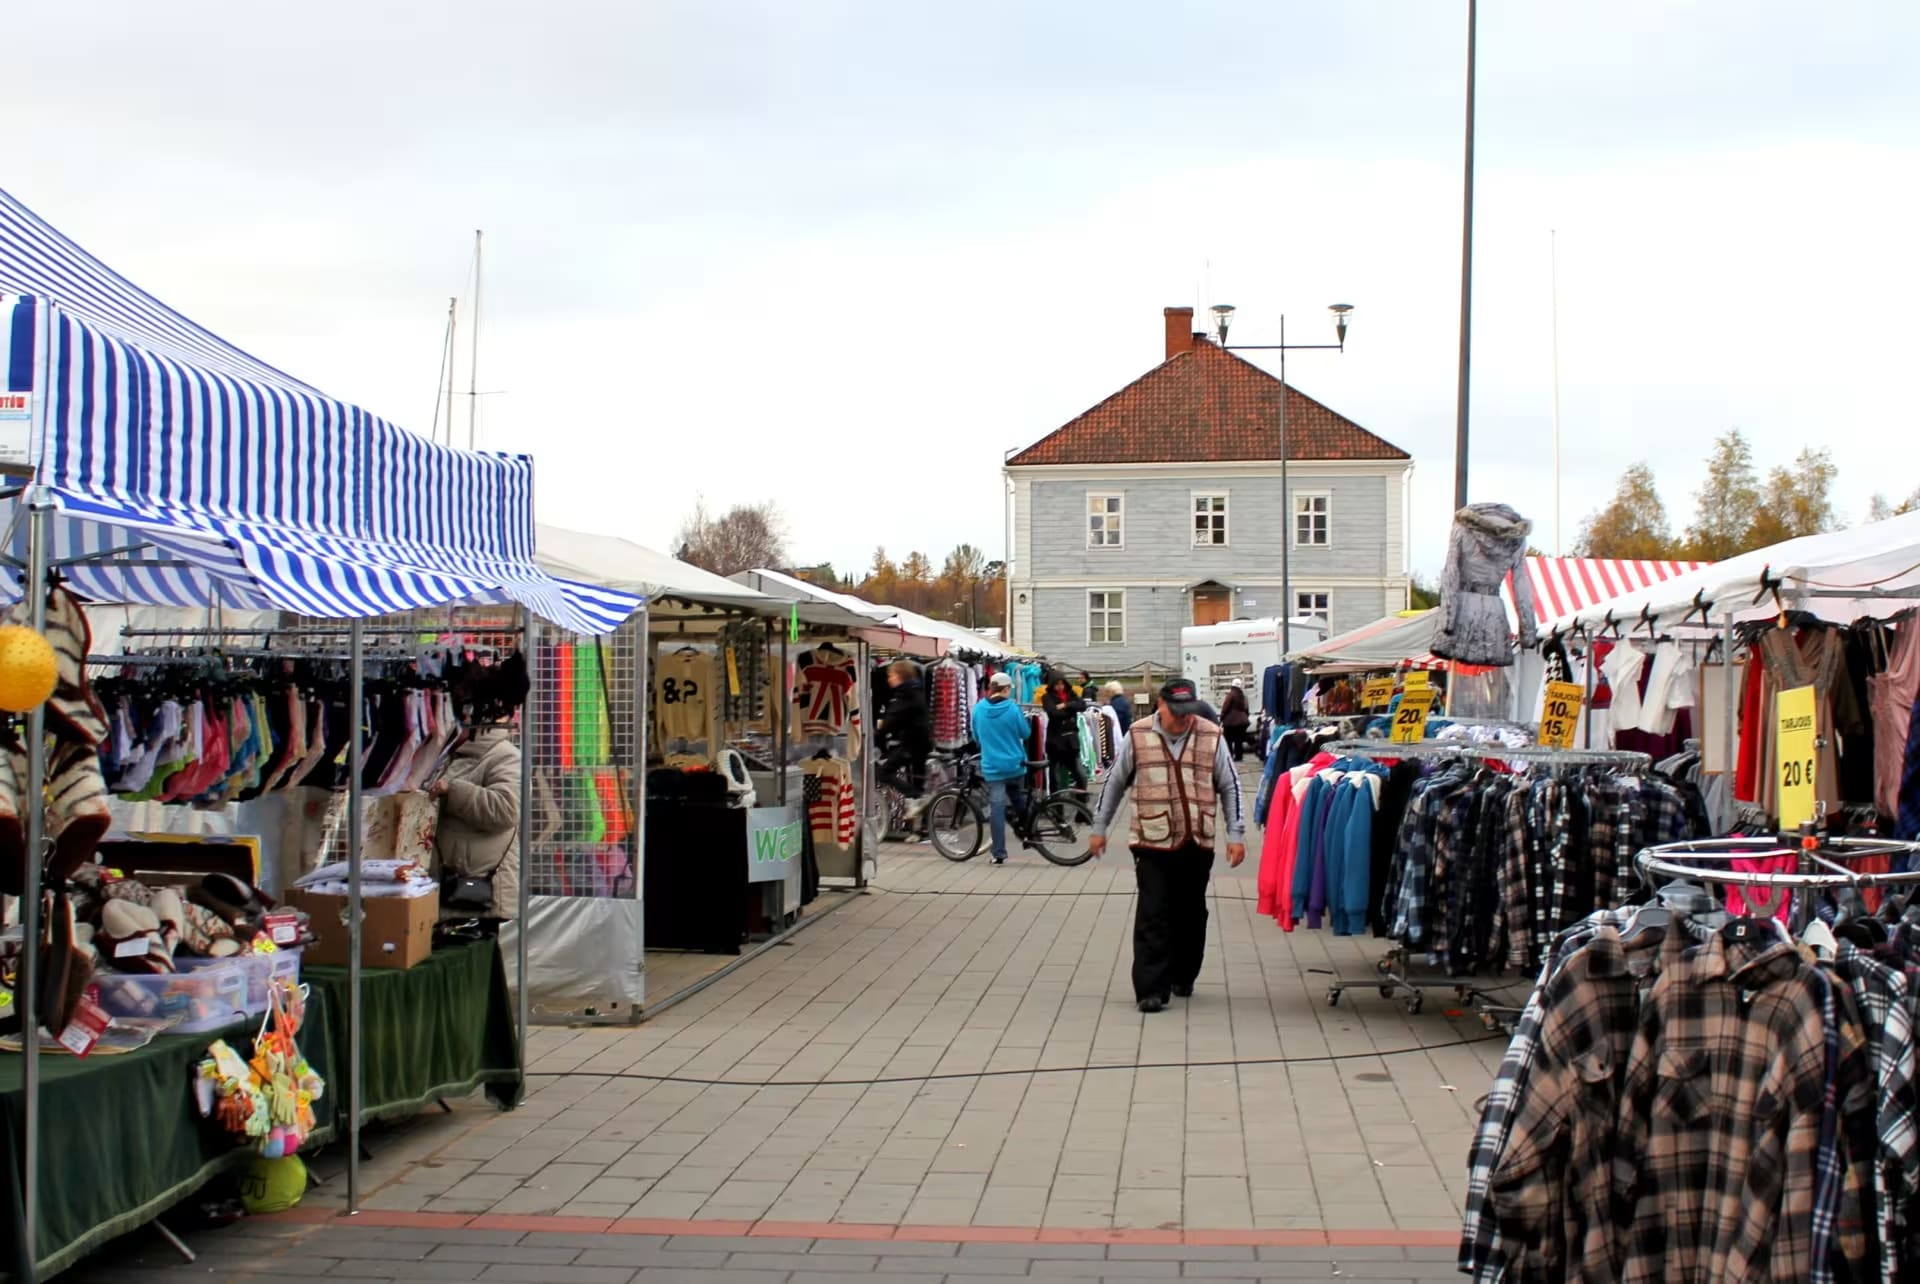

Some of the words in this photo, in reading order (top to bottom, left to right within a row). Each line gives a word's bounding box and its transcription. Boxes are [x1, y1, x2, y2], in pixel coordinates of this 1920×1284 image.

[1781, 715, 1812, 729] TARJOUS
[1783, 761, 1801, 787] 20
[1805, 759, 1813, 784] €
